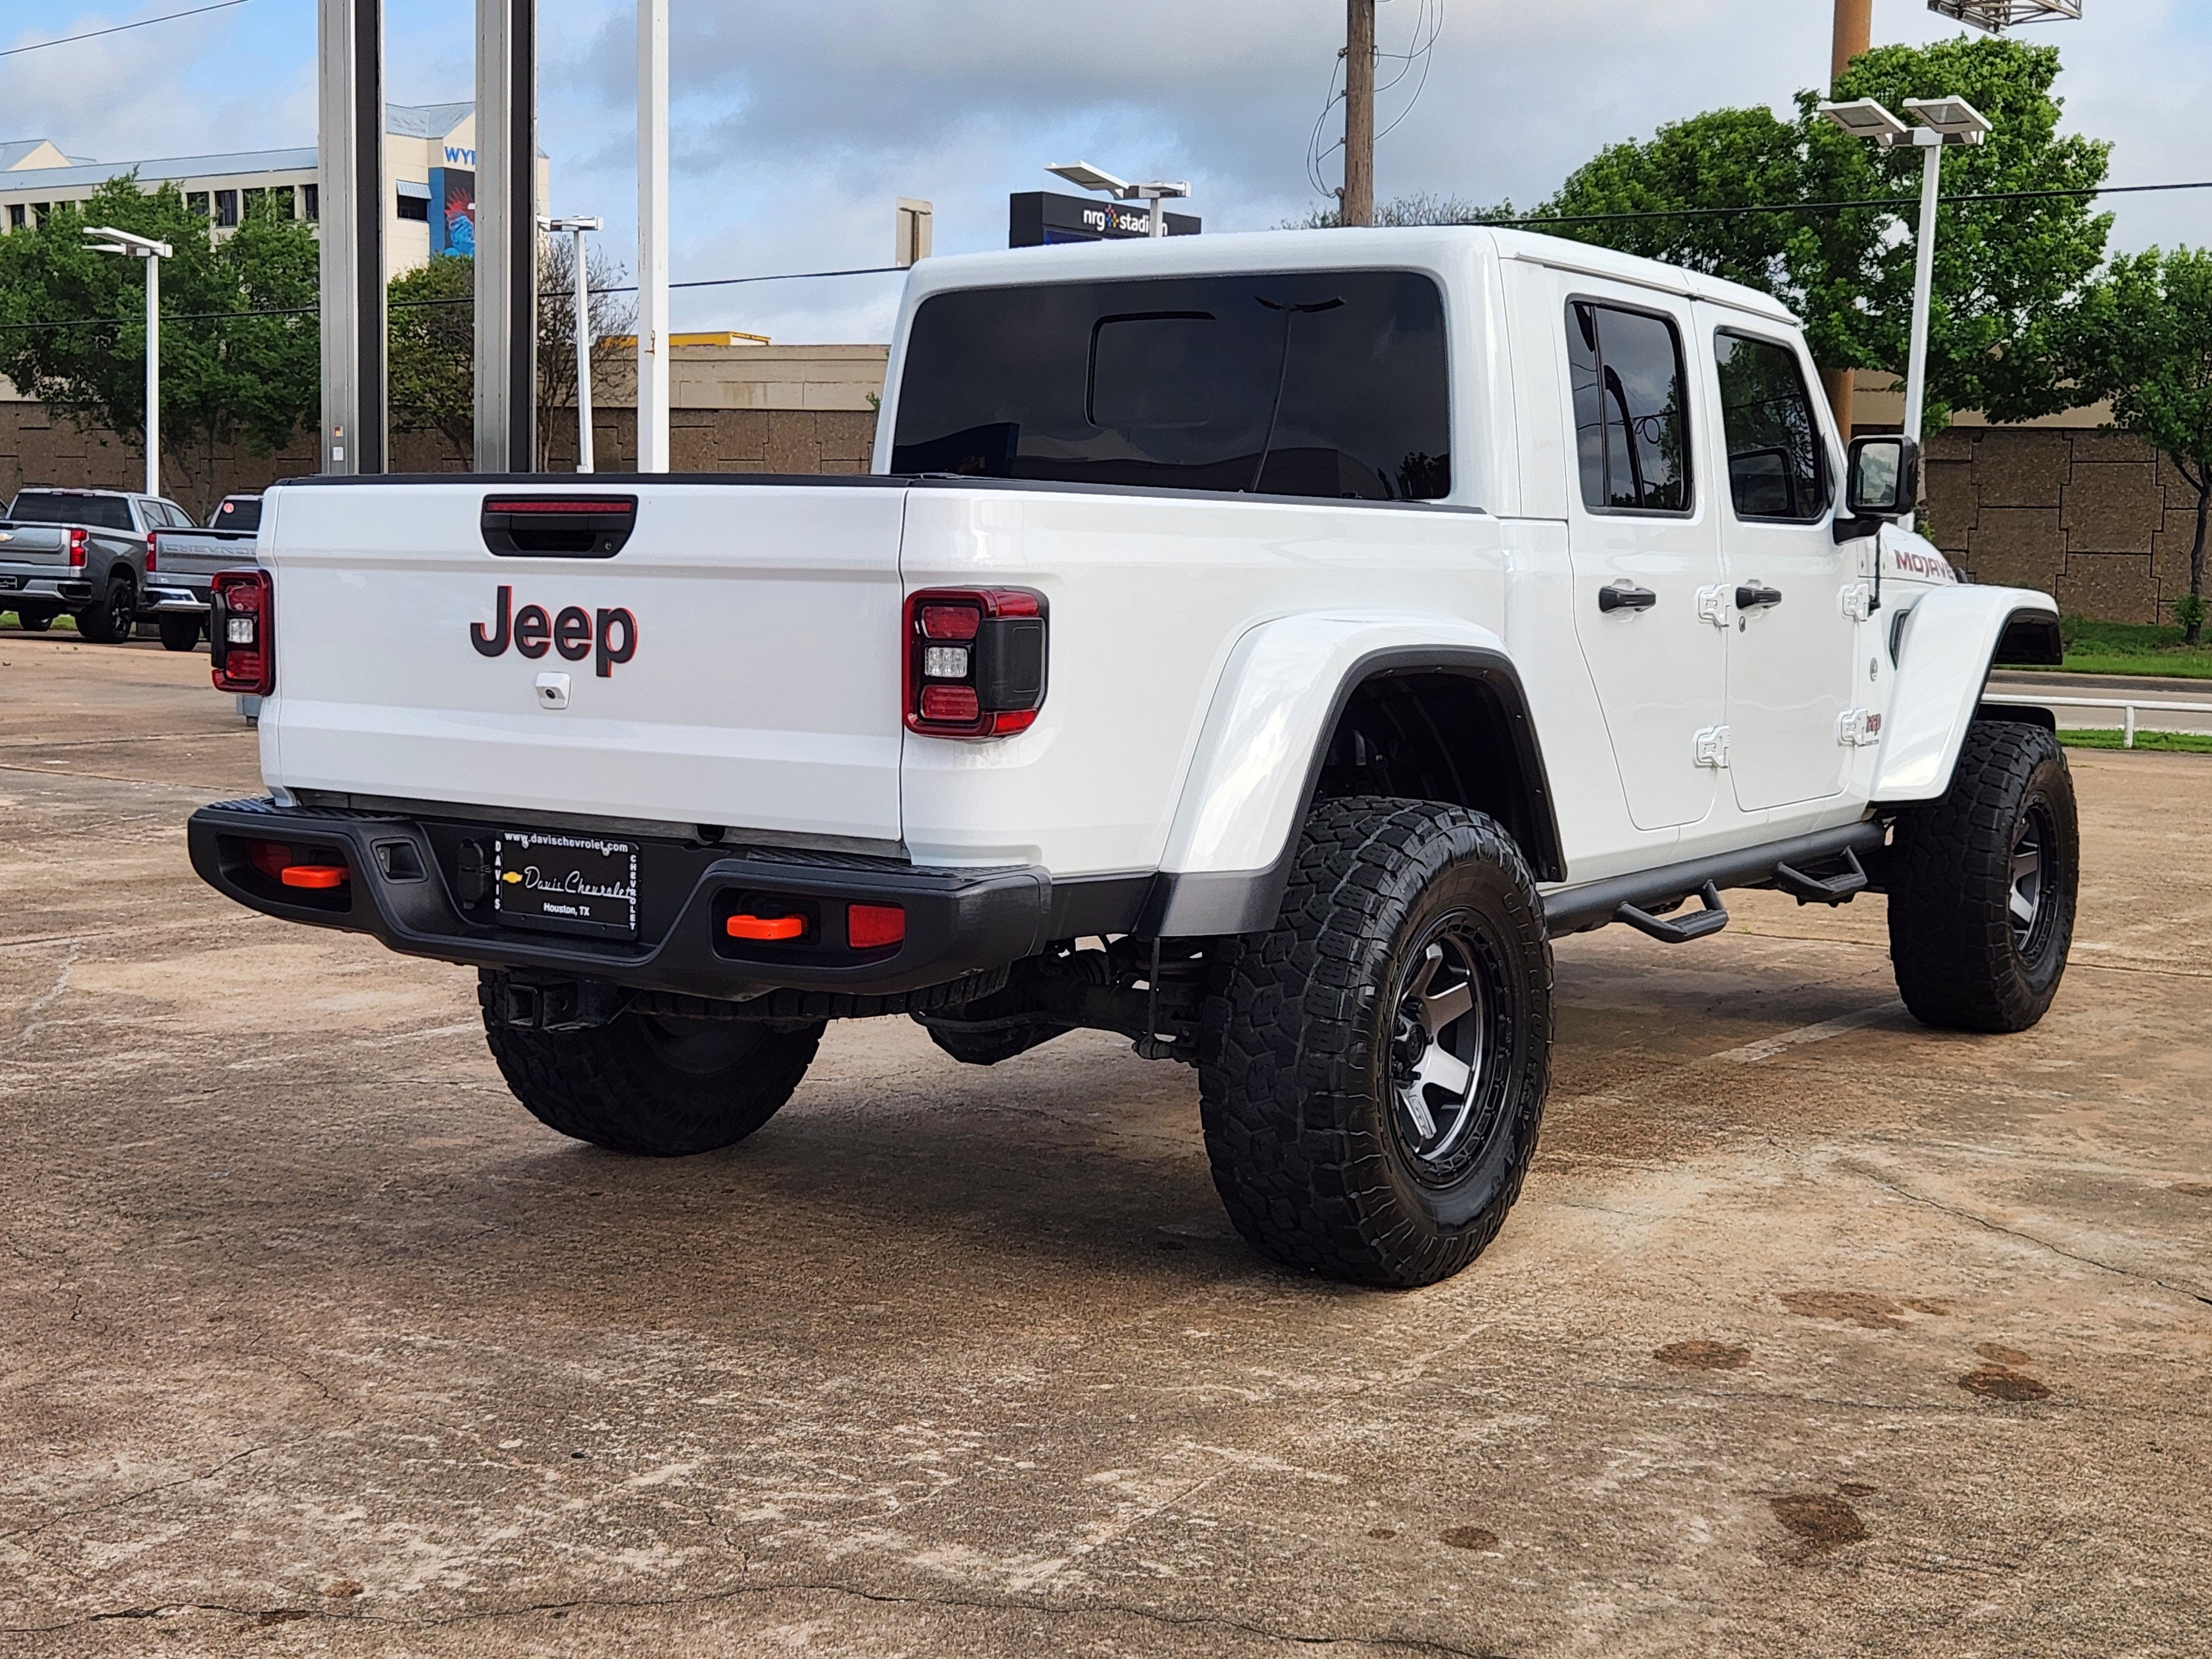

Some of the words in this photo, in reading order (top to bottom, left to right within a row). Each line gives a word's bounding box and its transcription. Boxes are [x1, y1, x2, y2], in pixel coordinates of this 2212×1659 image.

[1083, 210, 1105, 232] nrg
[1119, 213, 1168, 236] stadim
[1893, 549, 1955, 581] MOJAVE
[470, 585, 638, 678] Jeep
[504, 832, 628, 853] www.davischevrolet.com
[524, 865, 565, 891] Davis
[565, 870, 632, 899] Chevrolet
[544, 902, 578, 917] Houston,
[579, 905, 590, 916] TX
